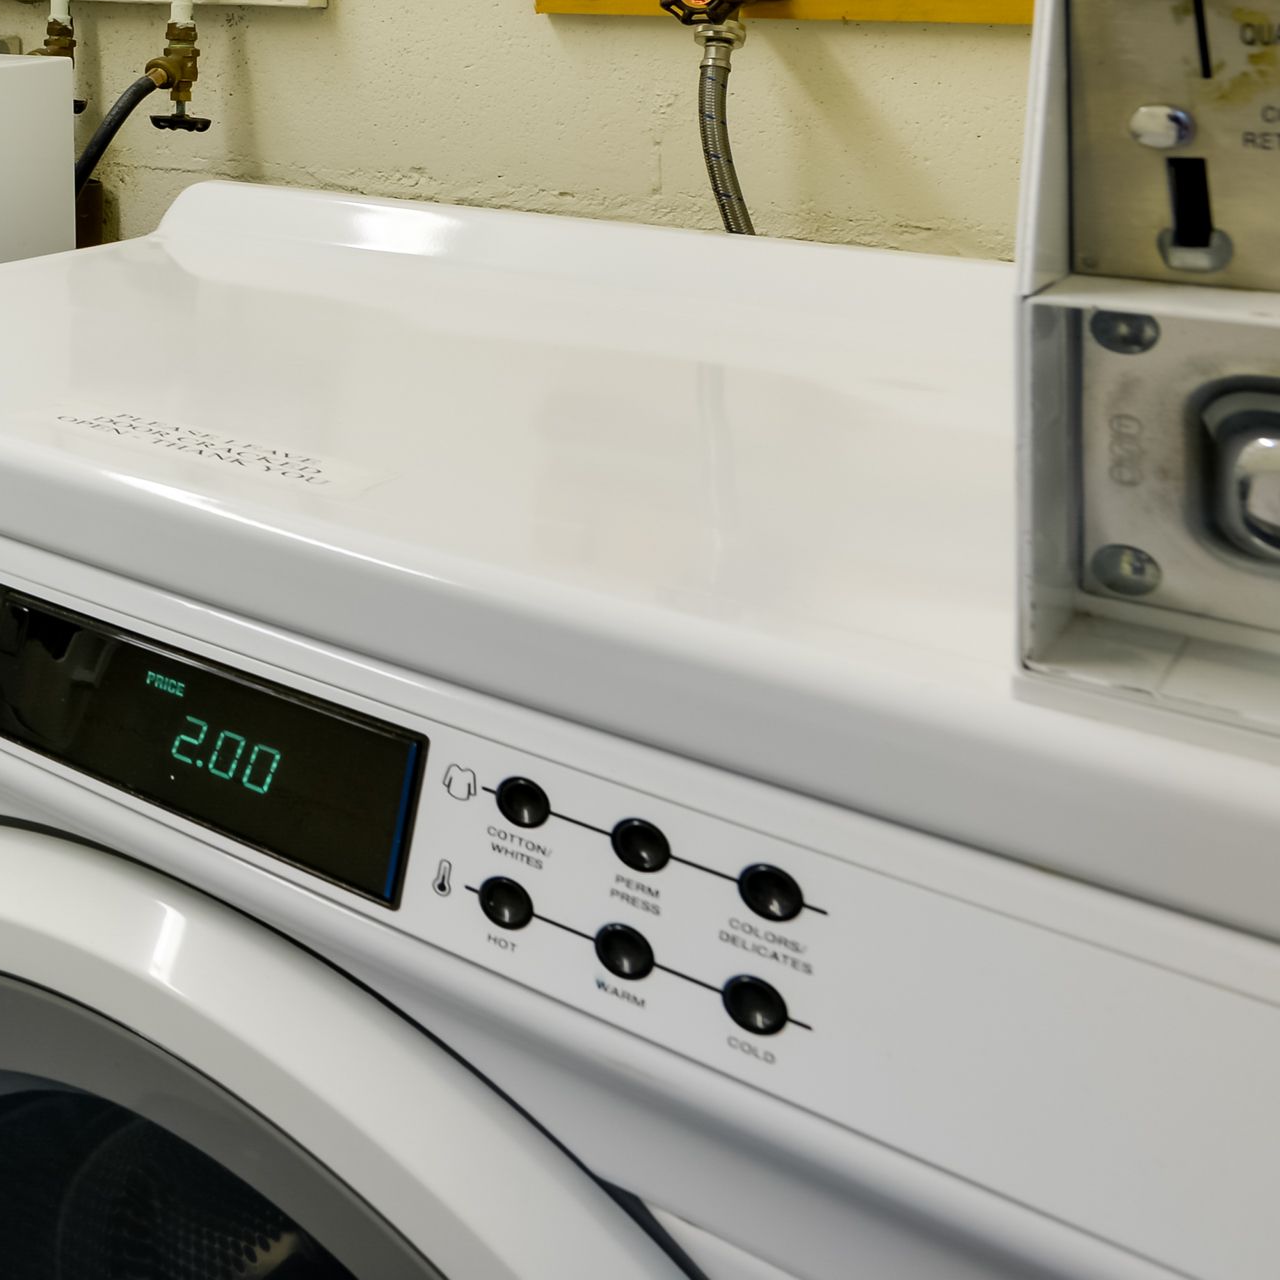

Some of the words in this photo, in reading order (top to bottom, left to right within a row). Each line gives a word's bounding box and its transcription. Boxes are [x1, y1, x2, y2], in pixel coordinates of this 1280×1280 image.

[146, 670, 185, 697] PRICE
[171, 715, 281, 795] 2.00
[487, 825, 553, 859] COTTON/
[490, 841, 544, 871] WHITES
[609, 887, 661, 916] PRESS
[614, 874, 660, 899] PERM
[486, 933, 518, 954] HOT
[728, 917, 807, 955] COLORS/
[718, 930, 814, 976] DELICATES
[595, 976, 646, 1009] WARM
[726, 1035, 776, 1065] COLD
